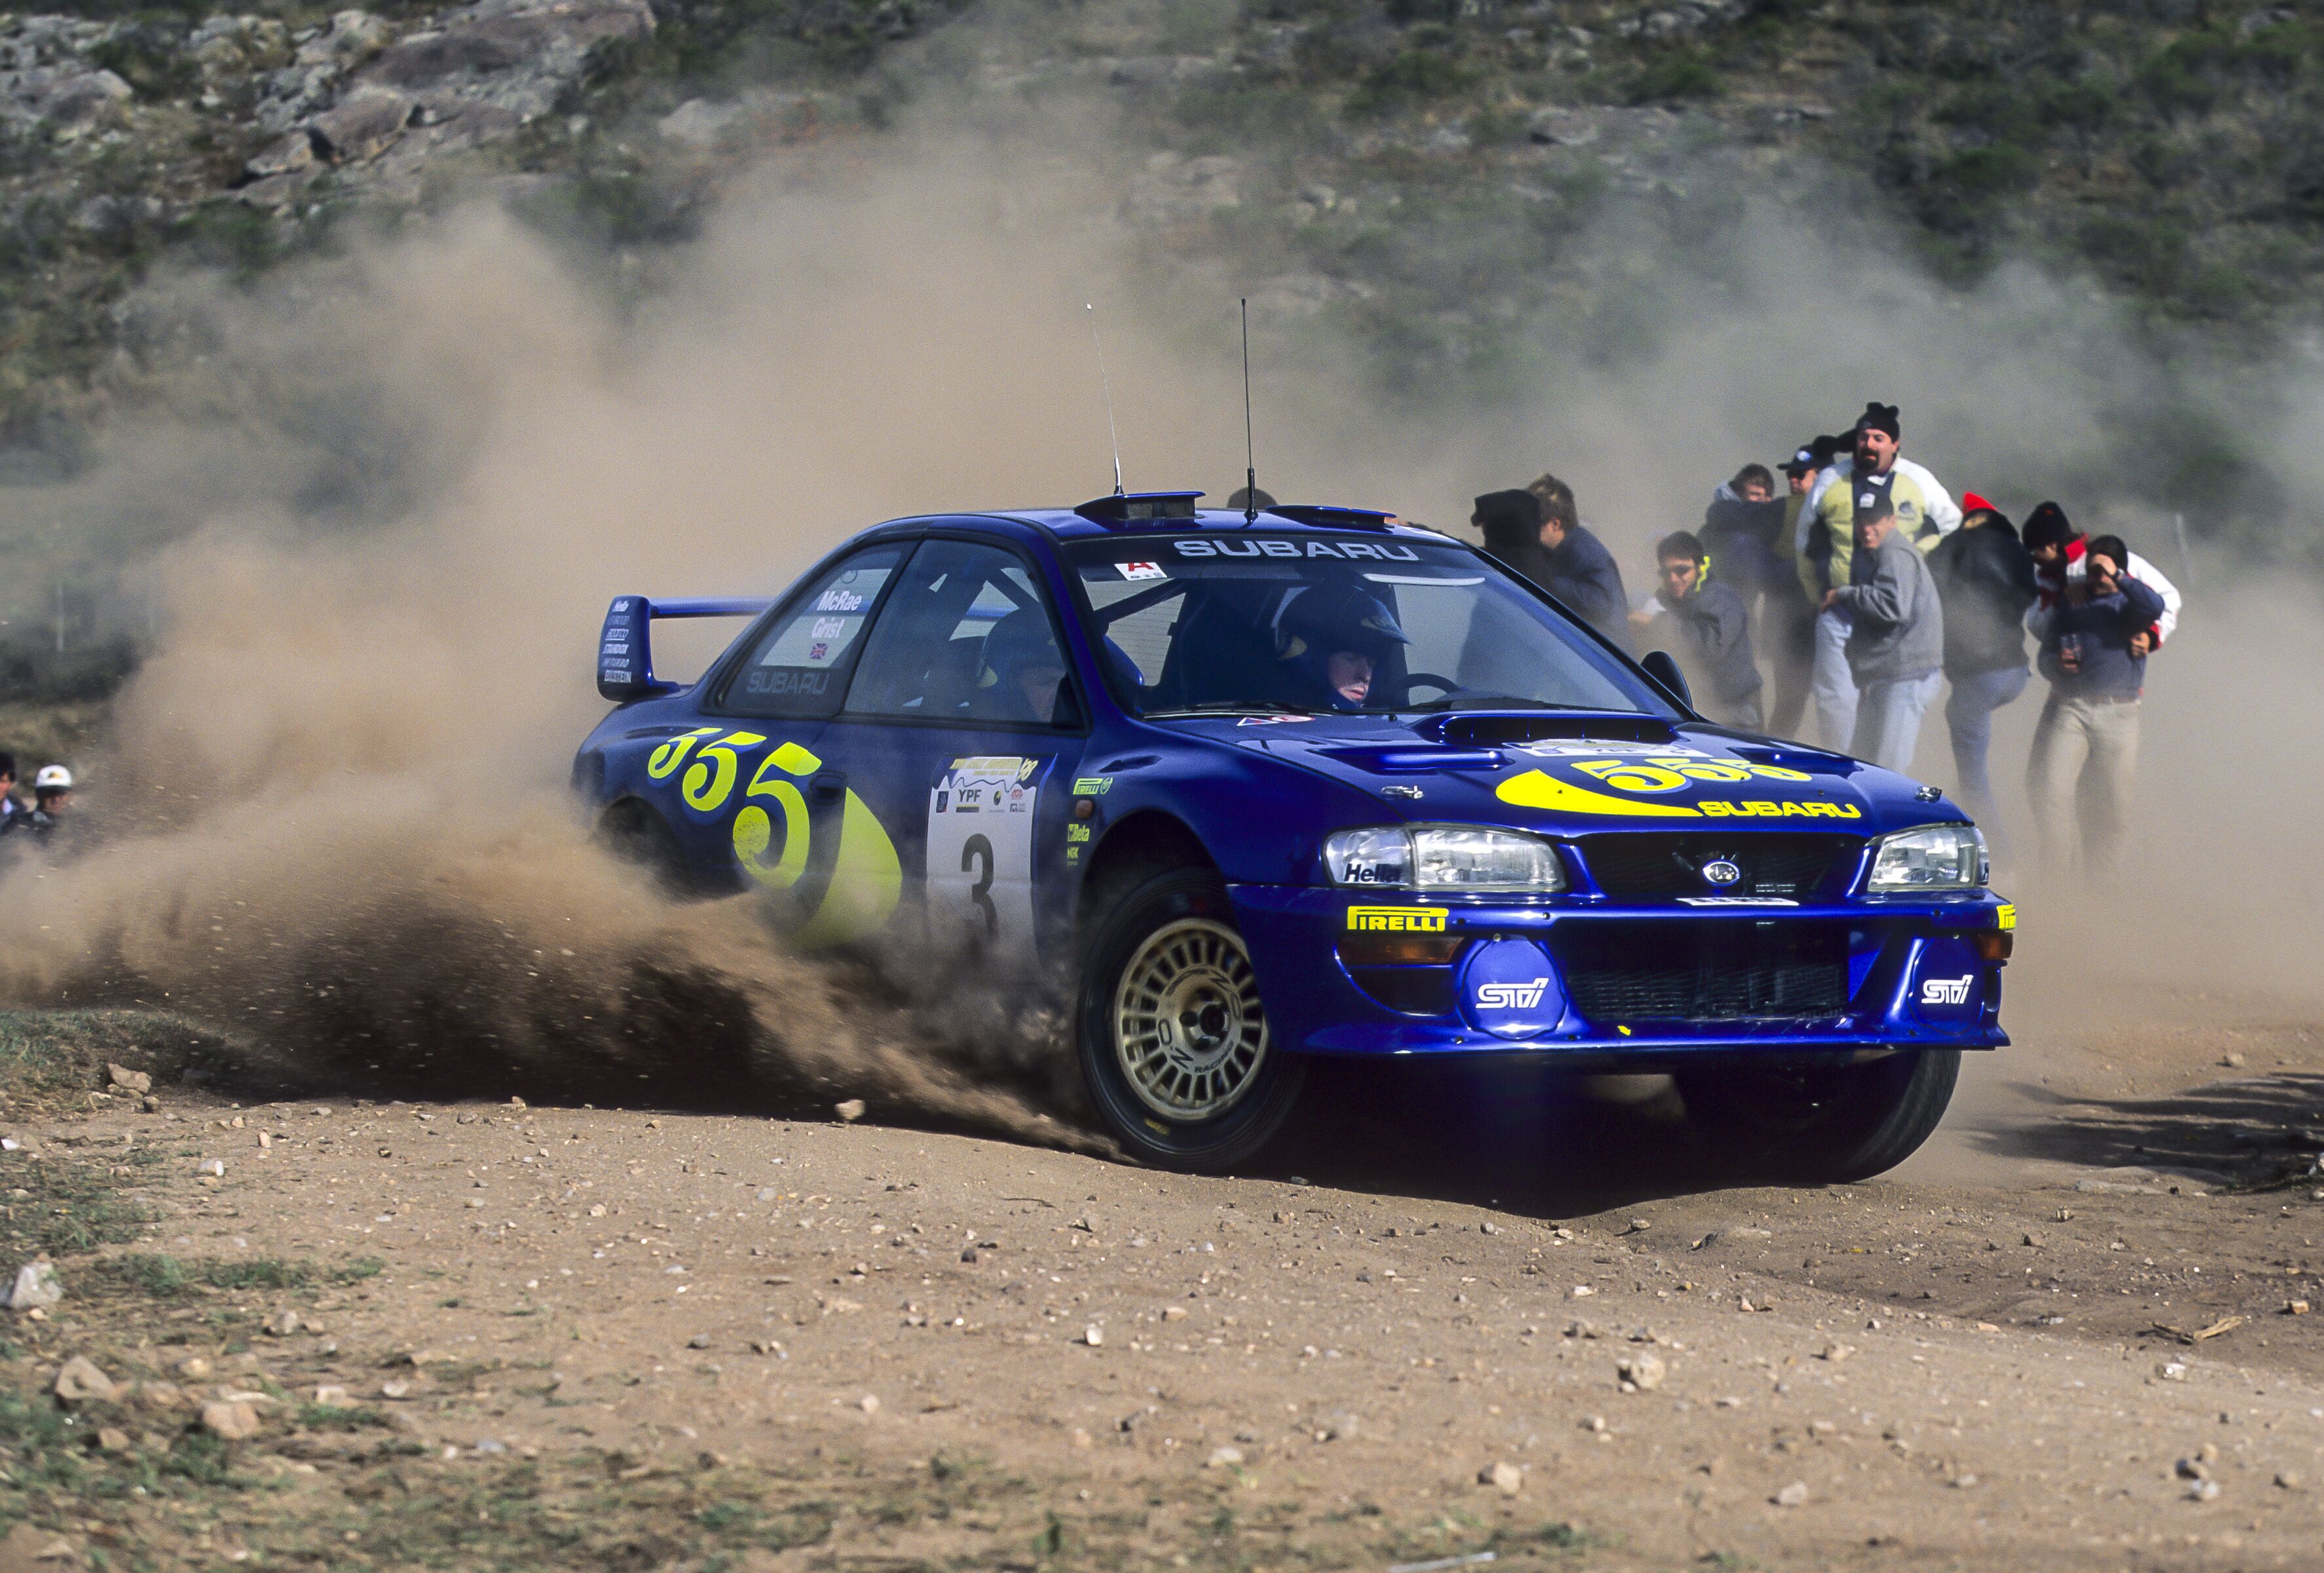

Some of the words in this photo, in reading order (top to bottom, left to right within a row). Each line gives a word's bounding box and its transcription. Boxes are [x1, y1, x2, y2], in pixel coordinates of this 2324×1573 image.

[1174, 540, 1420, 561] SUBARU
[817, 591, 863, 611] McRae
[811, 617, 845, 638] Grist
[747, 672, 830, 695] SUBARU
[1570, 758, 1812, 793] 555
[959, 789, 982, 802] YPF
[1073, 778, 1103, 795] PIRELLI
[648, 727, 823, 889] 555
[1698, 801, 1862, 819] SUBARU
[1073, 823, 1090, 842] Beta
[1344, 863, 1402, 883] Hella
[961, 833, 1000, 961] 3
[1347, 905, 1450, 931] PIRELLI
